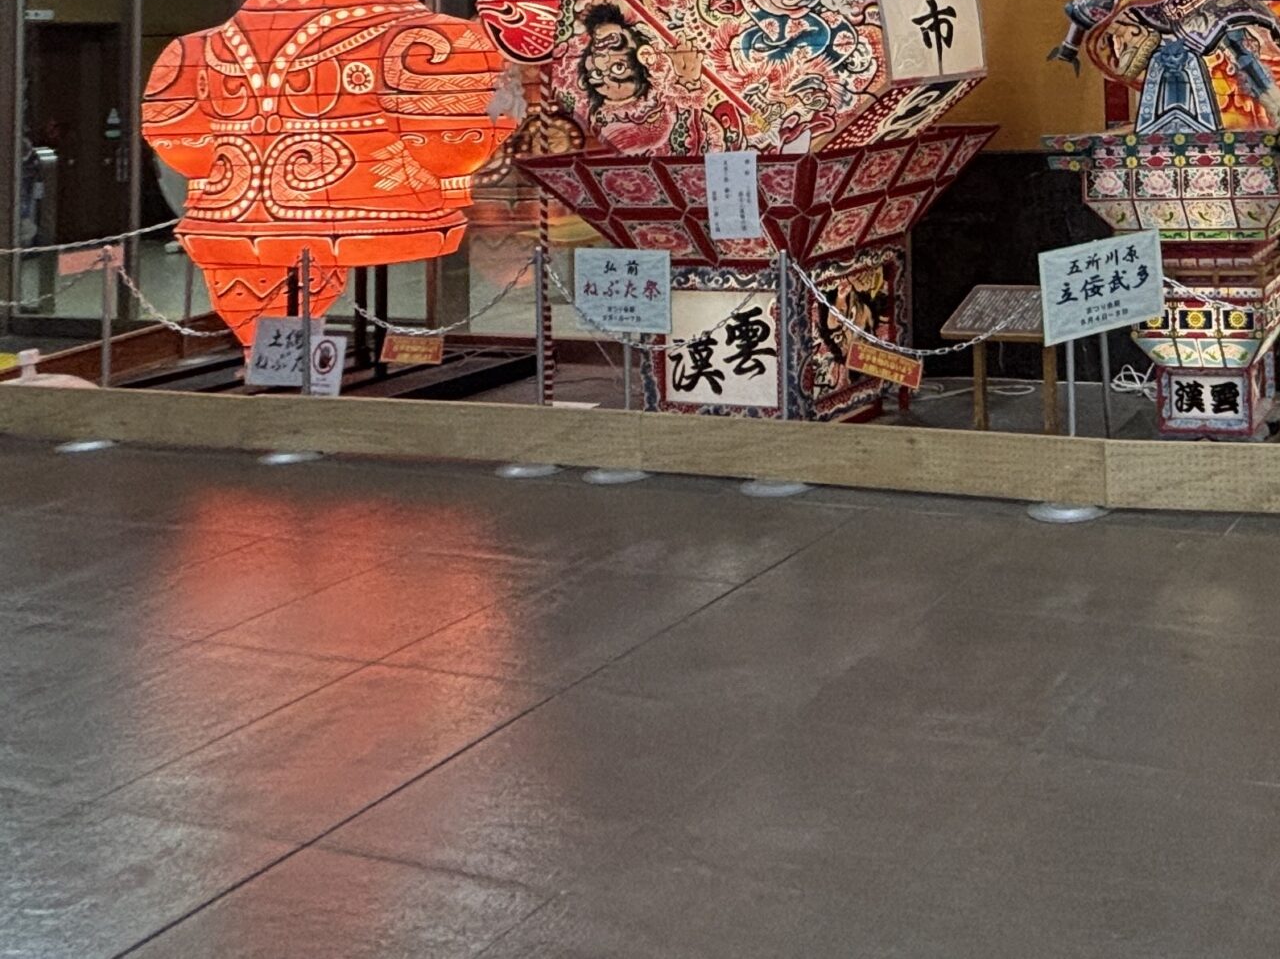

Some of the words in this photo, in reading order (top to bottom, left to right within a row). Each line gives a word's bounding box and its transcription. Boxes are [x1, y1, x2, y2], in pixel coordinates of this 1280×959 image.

[603, 260, 640, 276] 弘前
[1066, 244, 1140, 276] 五所川原
[1056, 264, 1150, 305] 立佞武多
